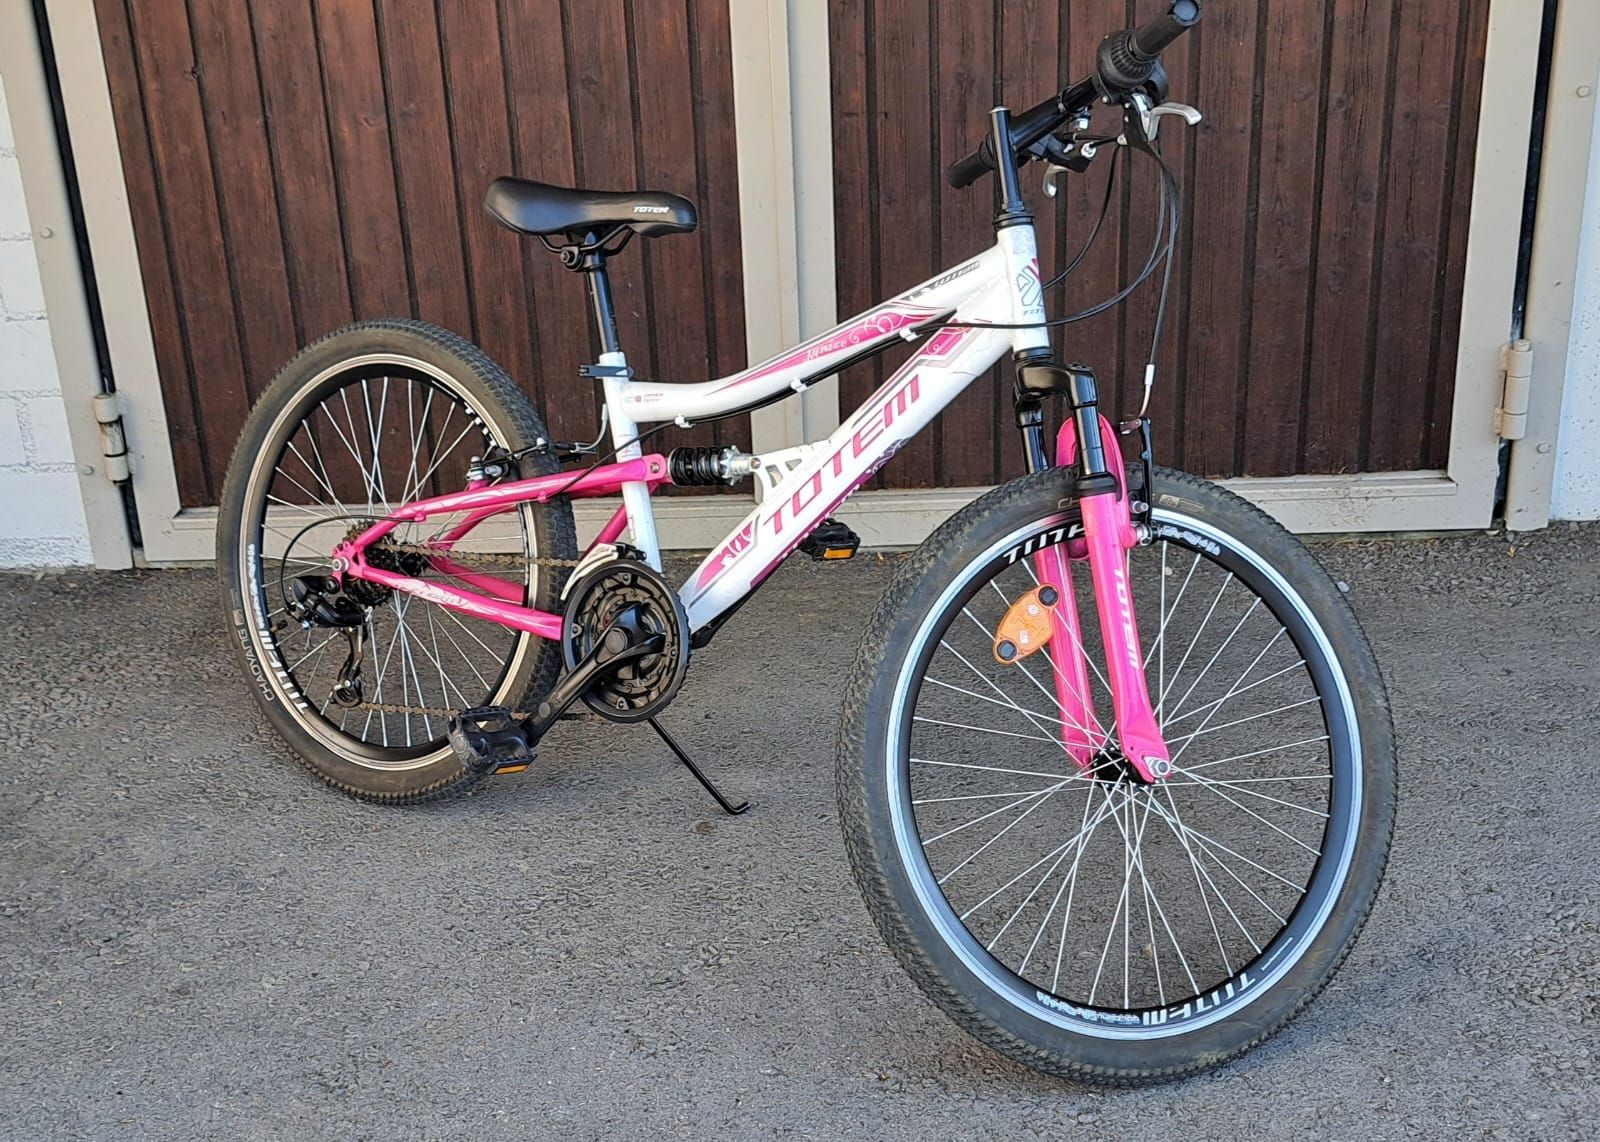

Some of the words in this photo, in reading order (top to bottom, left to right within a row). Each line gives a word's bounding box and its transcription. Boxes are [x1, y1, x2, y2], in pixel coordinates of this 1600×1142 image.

[763, 373, 920, 535] TOTEM
[237, 628, 275, 702] CHAOYANG
[1114, 568, 1139, 671] TOTEM
